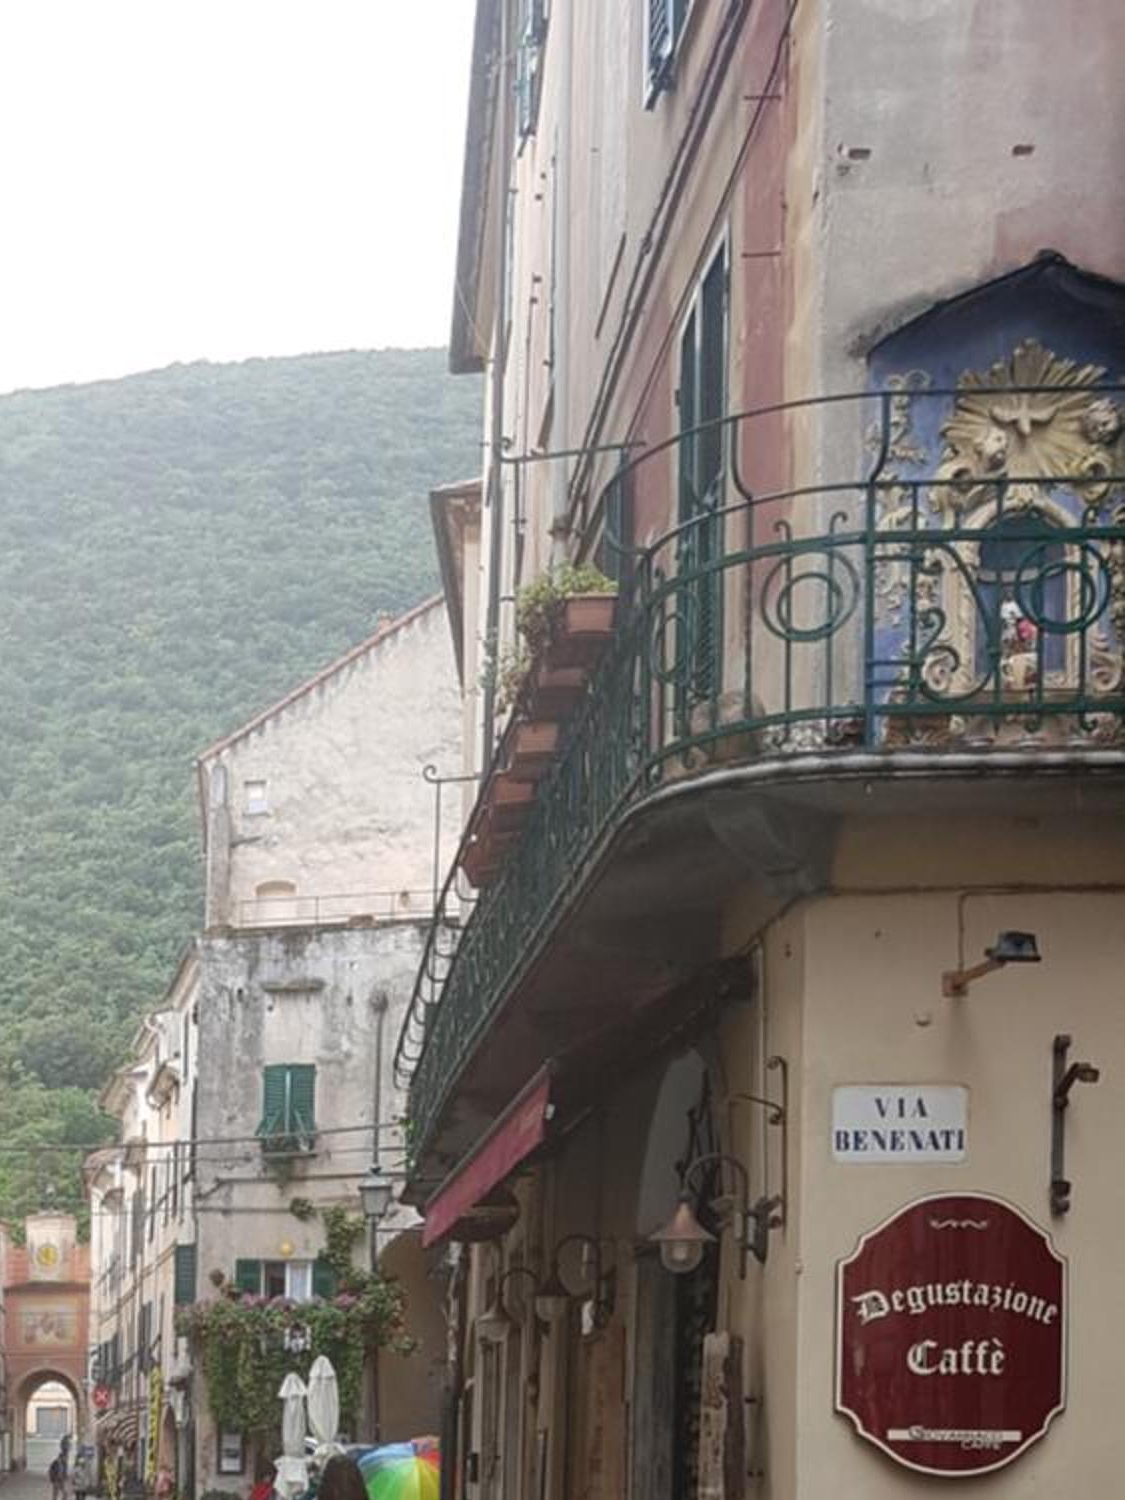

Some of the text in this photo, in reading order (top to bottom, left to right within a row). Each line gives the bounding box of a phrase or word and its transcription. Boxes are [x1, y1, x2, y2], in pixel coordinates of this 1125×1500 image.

[875, 1097, 928, 1118] VIA
[835, 1129, 964, 1152] BENENATI
[851, 1279, 1058, 1325] Degustazione
[906, 1337, 1005, 1375] Caffè
